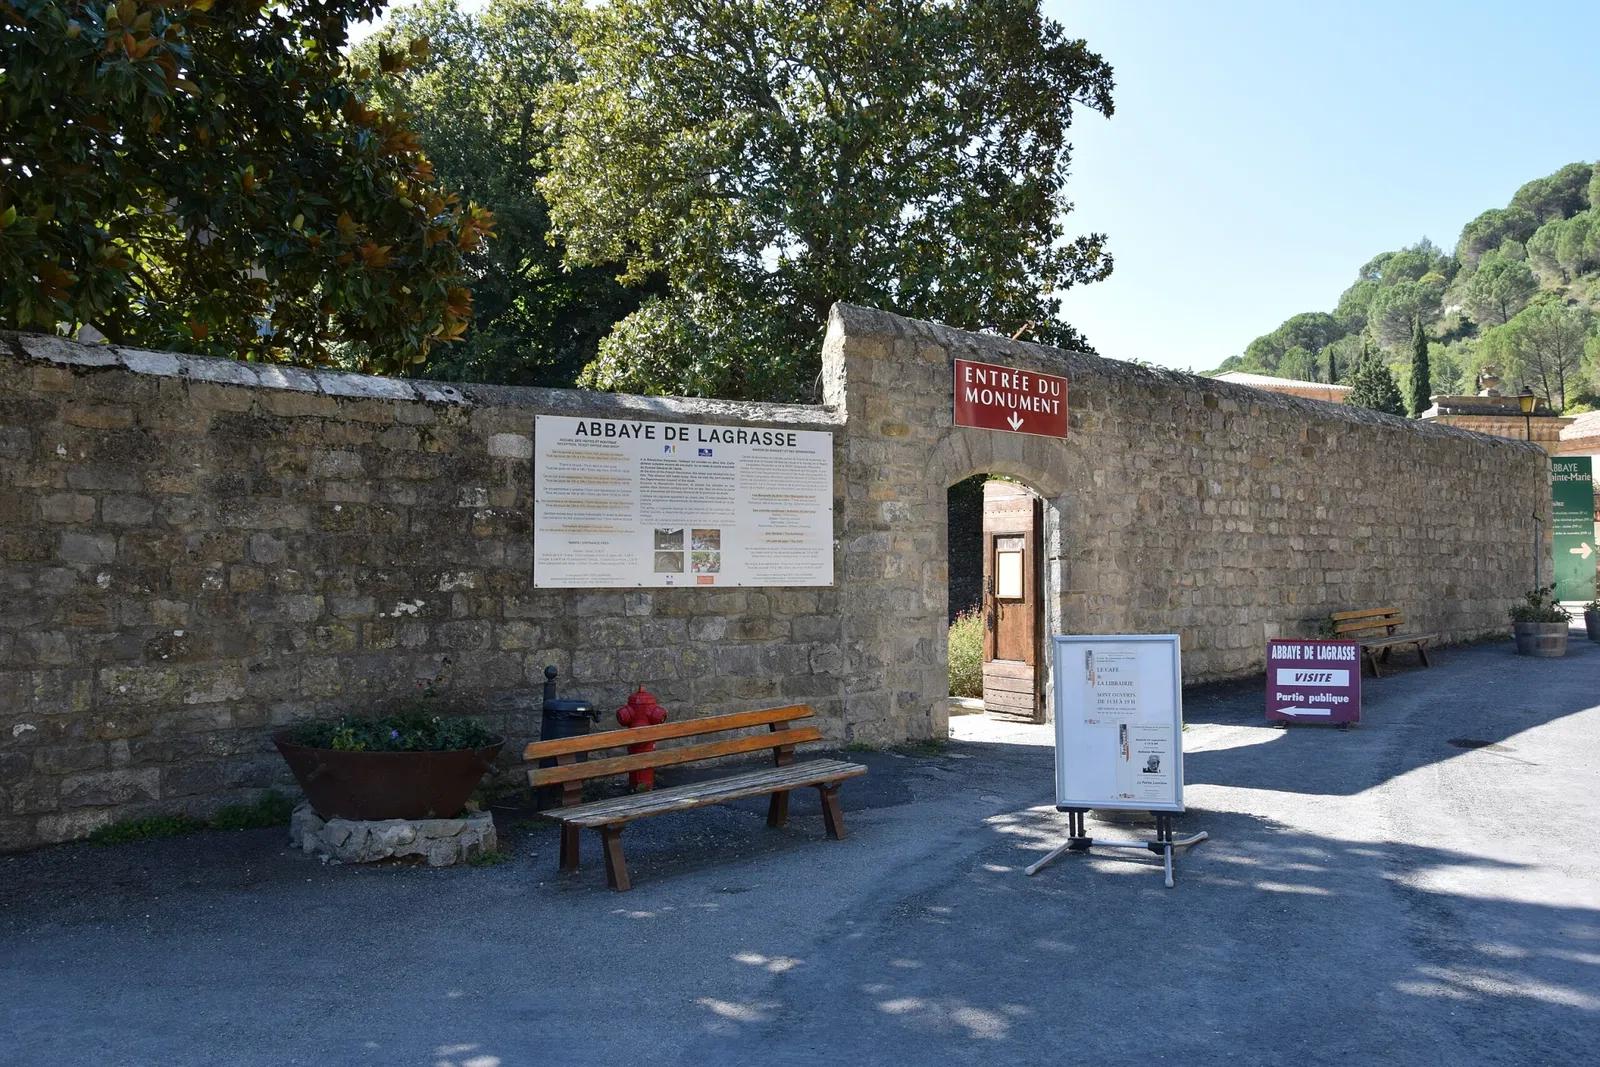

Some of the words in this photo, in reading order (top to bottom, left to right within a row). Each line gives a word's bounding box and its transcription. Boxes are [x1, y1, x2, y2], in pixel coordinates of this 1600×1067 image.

[965, 367, 1029, 391] ENTRÉE
[1038, 378, 1060, 396] DU
[965, 386, 1060, 414] MONUMENT
[575, 421, 656, 440] ABBAYE
[664, 426, 690, 442] DE
[698, 428, 797, 446] LAGRASSE
[1552, 473, 1592, 481] ainte-Marie
[1272, 645, 1300, 660] ABBAYE
[1304, 646, 1314, 660] DE
[1317, 646, 1356, 660] LAGRASSE
[1295, 673, 1332, 682] VISITE
[1276, 692, 1304, 702] Partie
[1309, 693, 1349, 704] publique
